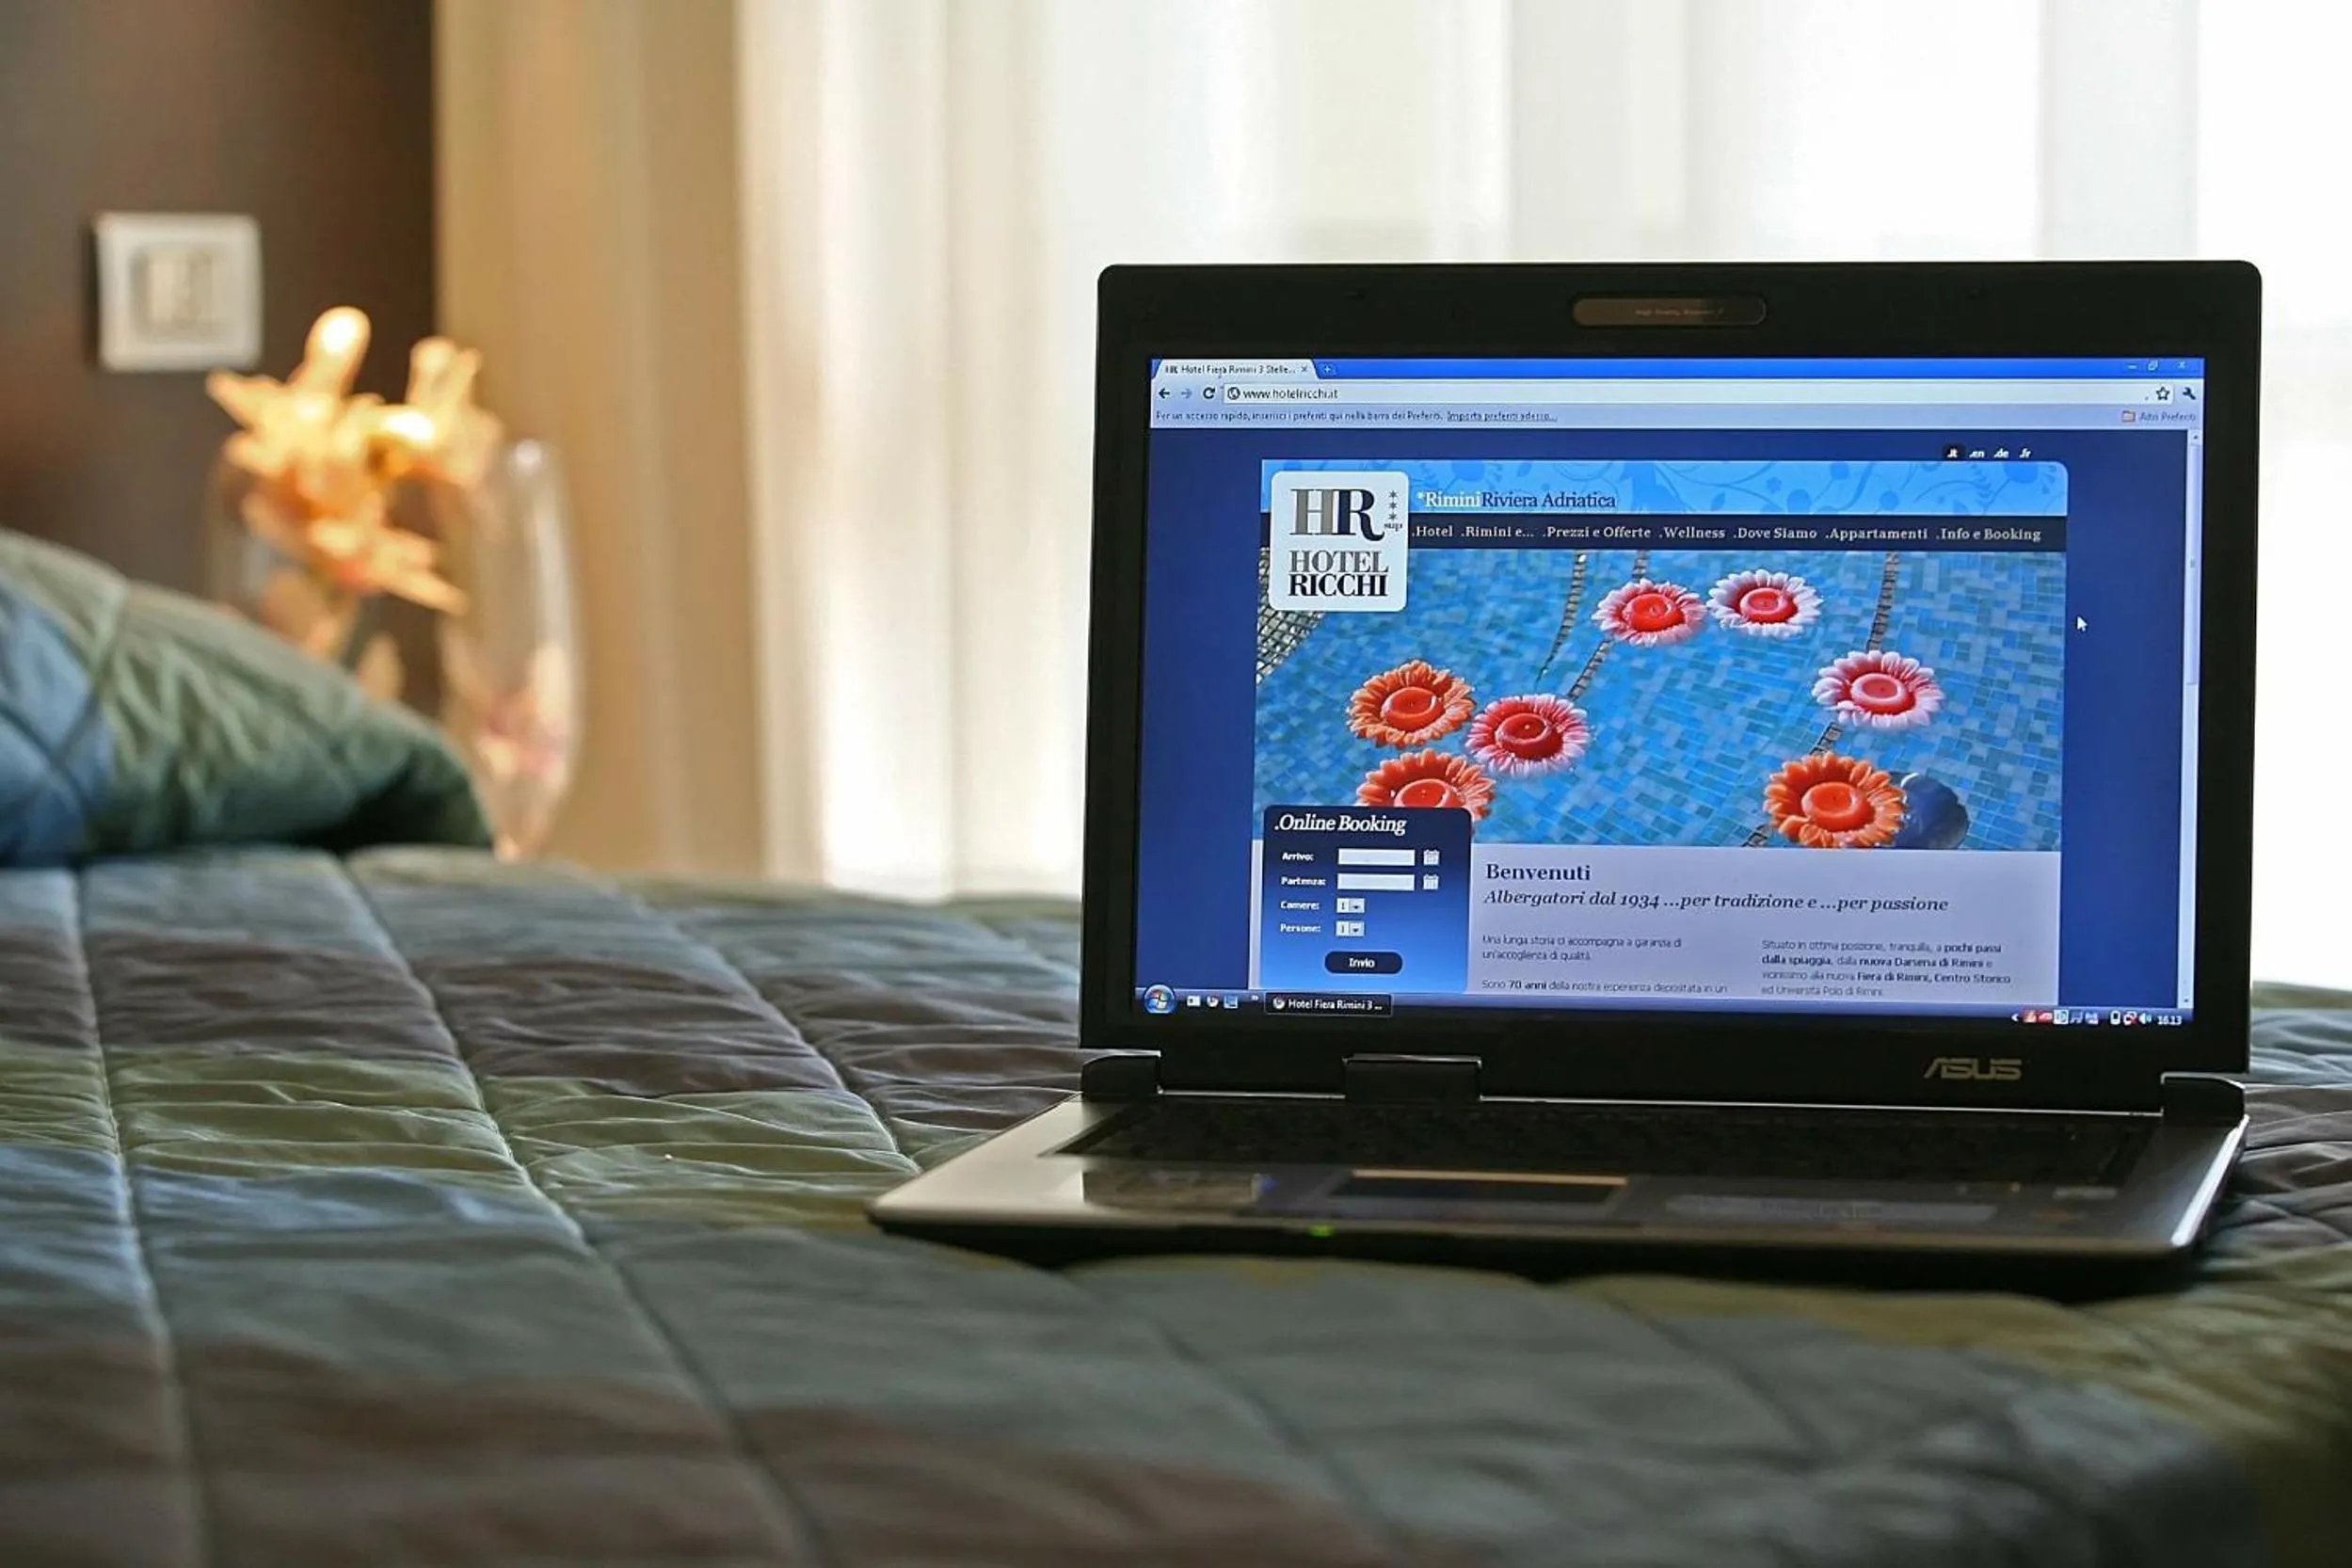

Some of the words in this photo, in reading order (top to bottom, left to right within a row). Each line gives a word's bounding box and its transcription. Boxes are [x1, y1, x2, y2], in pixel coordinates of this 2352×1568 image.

[1182, 365, 1205, 375] Hotel
[1242, 387, 1338, 400] www.hotelricchi.it
[1542, 491, 1617, 509] Adriatica
[1289, 488, 1385, 541] HR
[1592, 529, 1600, 538] e
[1603, 526, 1652, 538] Offerte
[1773, 527, 1818, 540] Siamo
[1973, 532, 1981, 541] e
[1983, 528, 2043, 544] Booking
[1288, 550, 1390, 573] HOTEL
[1288, 573, 1390, 597] RICCHI
[1337, 814, 1407, 837] Booking
[1282, 851, 1315, 861] Arrivo:
[1486, 862, 1592, 881] Benvenuti
[1281, 876, 1327, 887] Partenza:
[1280, 901, 1320, 911] Camere:
[1484, 888, 1586, 907] Albergatori
[1589, 890, 1617, 905] dal
[1620, 893, 1660, 909] 1934
[1714, 892, 1804, 908] tradizione
[1808, 898, 1817, 908] e
[1869, 896, 1949, 914] passione
[1280, 922, 1321, 933] Persone:
[1482, 935, 1501, 945] Una
[1503, 935, 1528, 947] lunga
[1568, 938, 1624, 949] accompagna
[1762, 940, 1796, 950] Situato
[1944, 943, 1973, 953] pochi
[1976, 943, 2002, 954] passi
[1348, 957, 1376, 968] Invio
[1762, 954, 1786, 965] dalla
[1859, 956, 1892, 967] nuova
[1857, 971, 1881, 982] Fiera
[1934, 973, 1971, 983] Centro
[1973, 974, 2011, 984] Storico
[1481, 979, 1507, 988] Sono
[1509, 980, 1522, 989] 70
[1524, 980, 1547, 990] anni
[1288, 997, 1314, 1009] Hotel
[1315, 997, 1336, 1010] Fiera
[1336, 998, 1365, 1010] Rimini
[1923, 1056, 2024, 1080] ASUS
